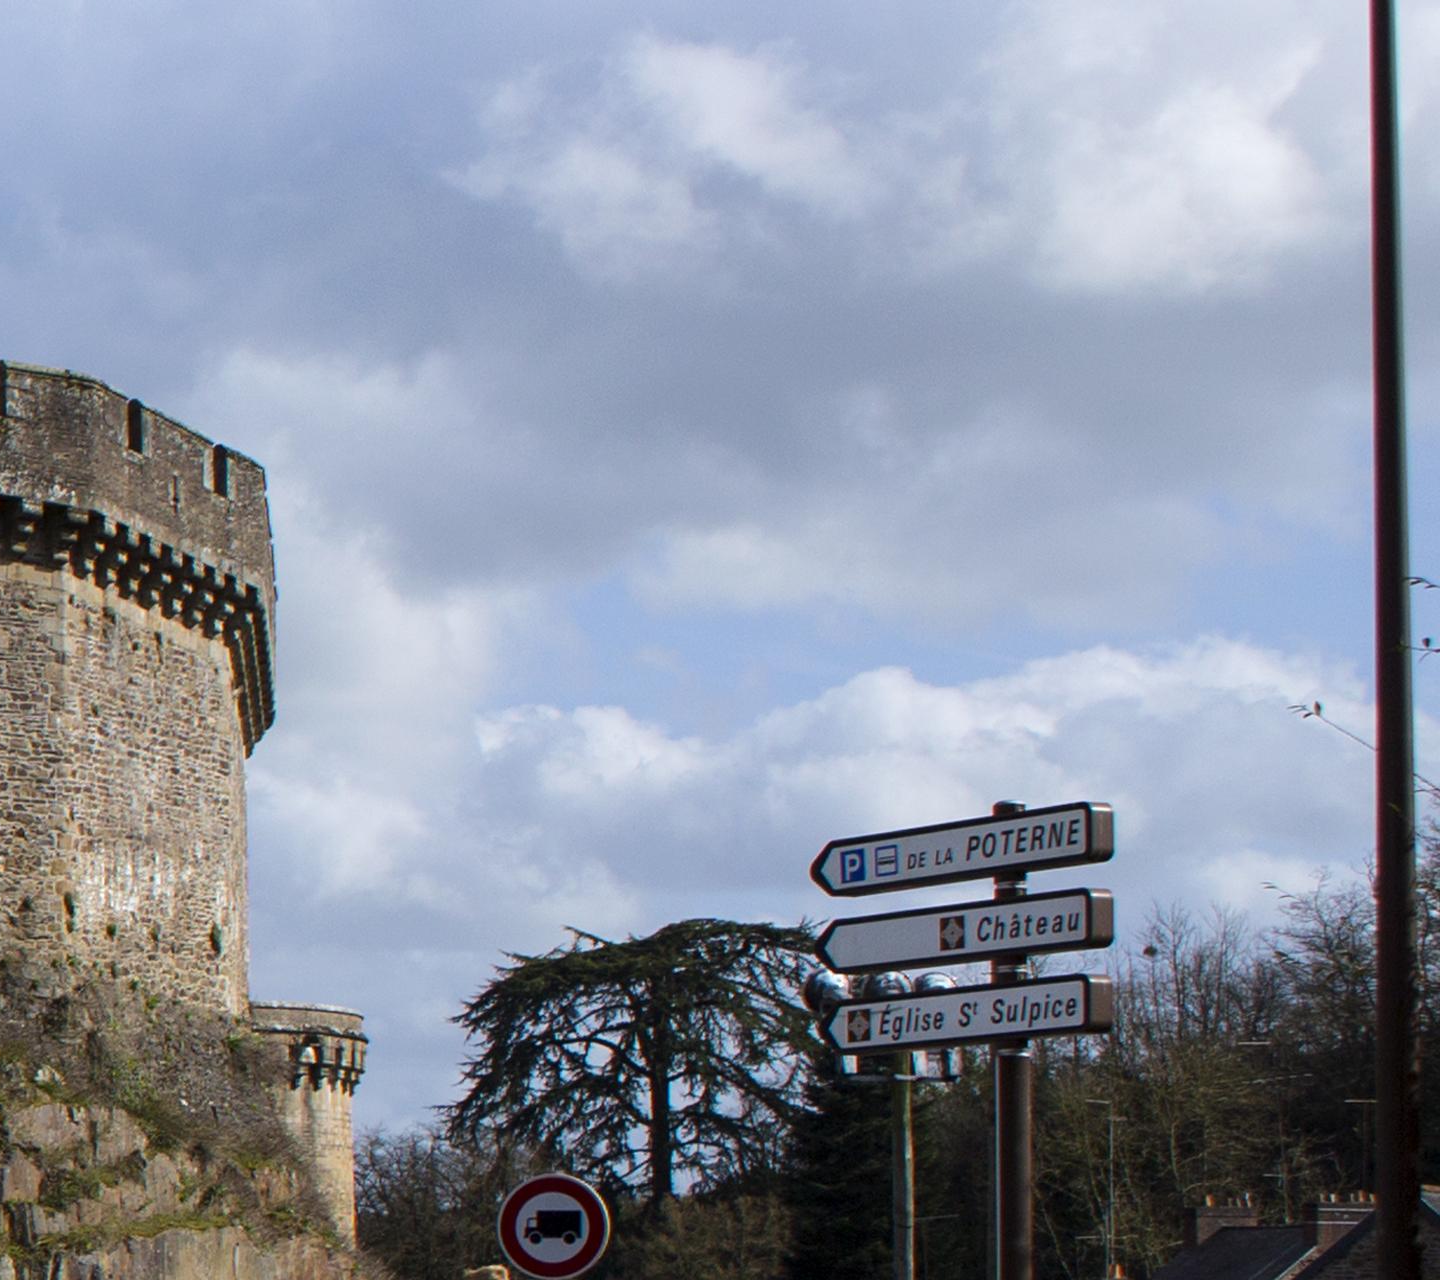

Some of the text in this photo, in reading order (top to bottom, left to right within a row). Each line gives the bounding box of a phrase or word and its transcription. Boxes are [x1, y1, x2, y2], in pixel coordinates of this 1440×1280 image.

[907, 854, 926, 869] DE
[935, 848, 953, 866] LA
[965, 818, 1080, 861] POTERNE
[977, 912, 1079, 942] Château
[880, 993, 1077, 1041] Église St Sulpice
